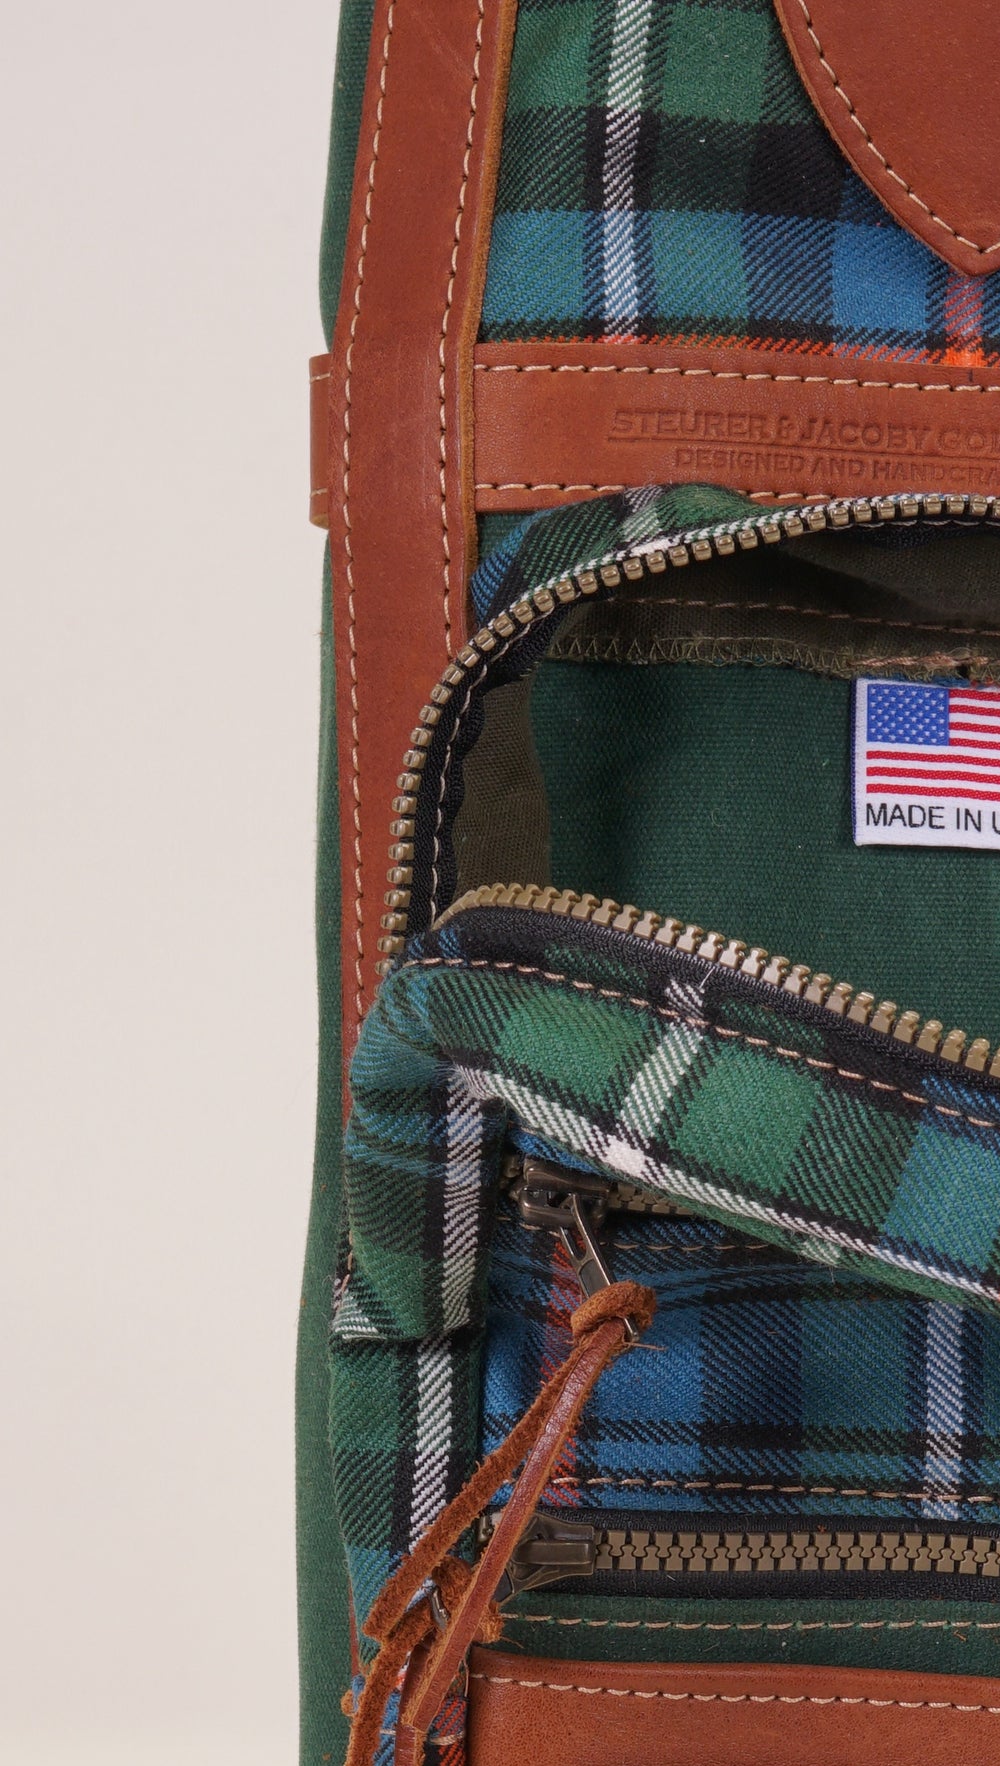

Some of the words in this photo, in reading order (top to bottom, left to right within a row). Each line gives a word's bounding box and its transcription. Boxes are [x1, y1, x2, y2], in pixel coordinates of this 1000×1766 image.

[612, 409, 771, 438] STEURER
[776, 414, 797, 440] &
[800, 416, 928, 450] JACOBY
[676, 448, 805, 473] DESIGNED
[811, 455, 864, 477] AND
[865, 802, 946, 830] MADE
[956, 807, 982, 833] IN
